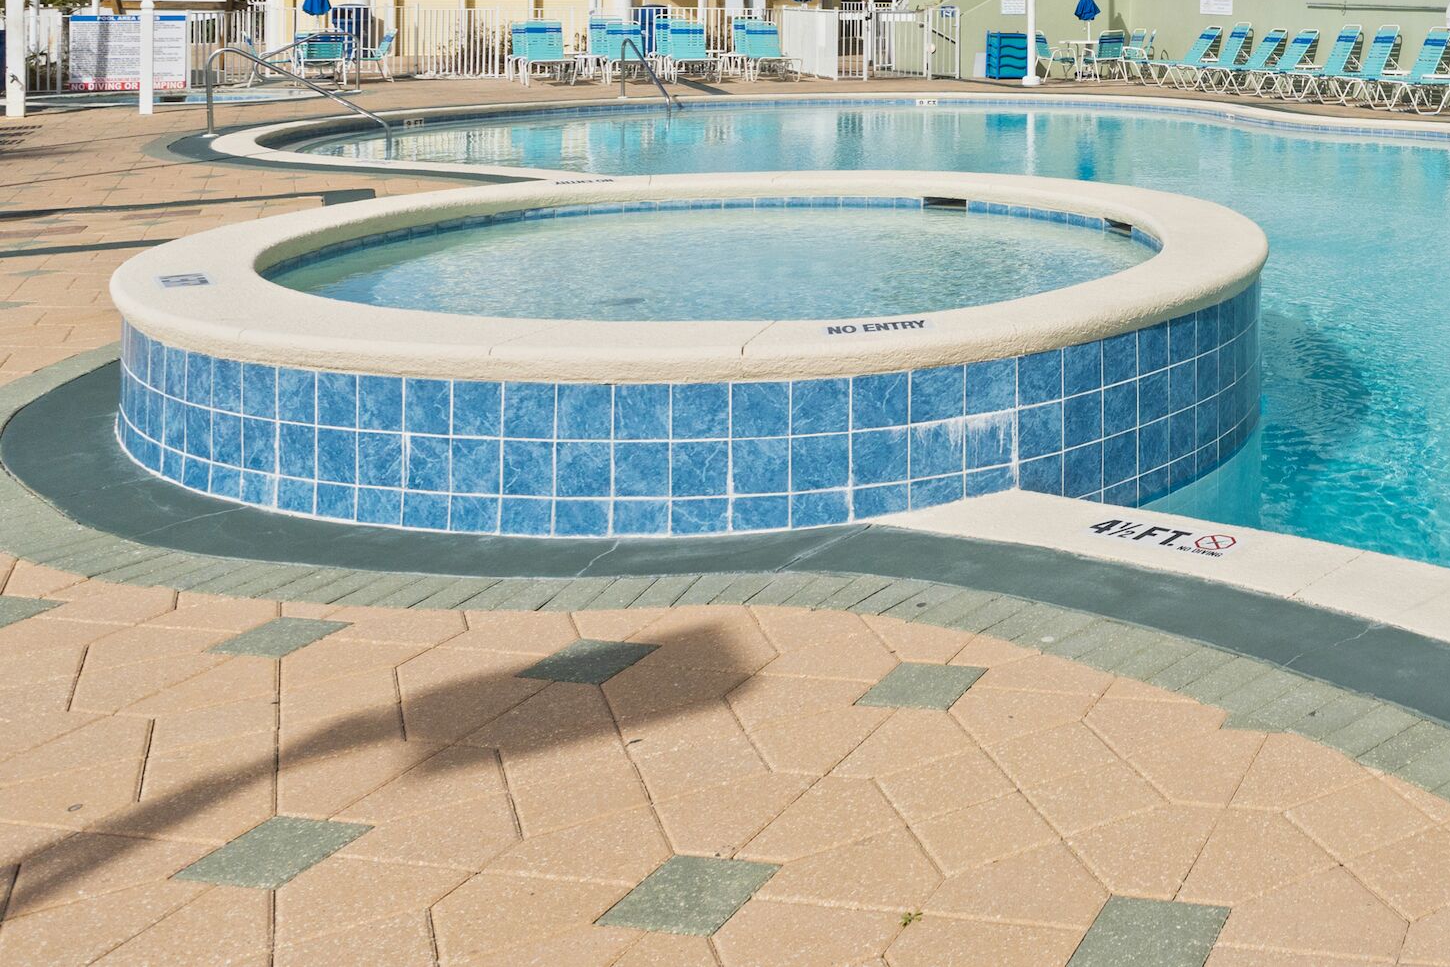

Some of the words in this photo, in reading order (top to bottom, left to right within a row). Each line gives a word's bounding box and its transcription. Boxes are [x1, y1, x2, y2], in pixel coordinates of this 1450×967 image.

[70, 82, 85, 91] NO
[87, 82, 122, 91] DIVING
[124, 82, 139, 90] OR
[827, 325, 857, 335] NO
[862, 320, 926, 332] ENTRY
